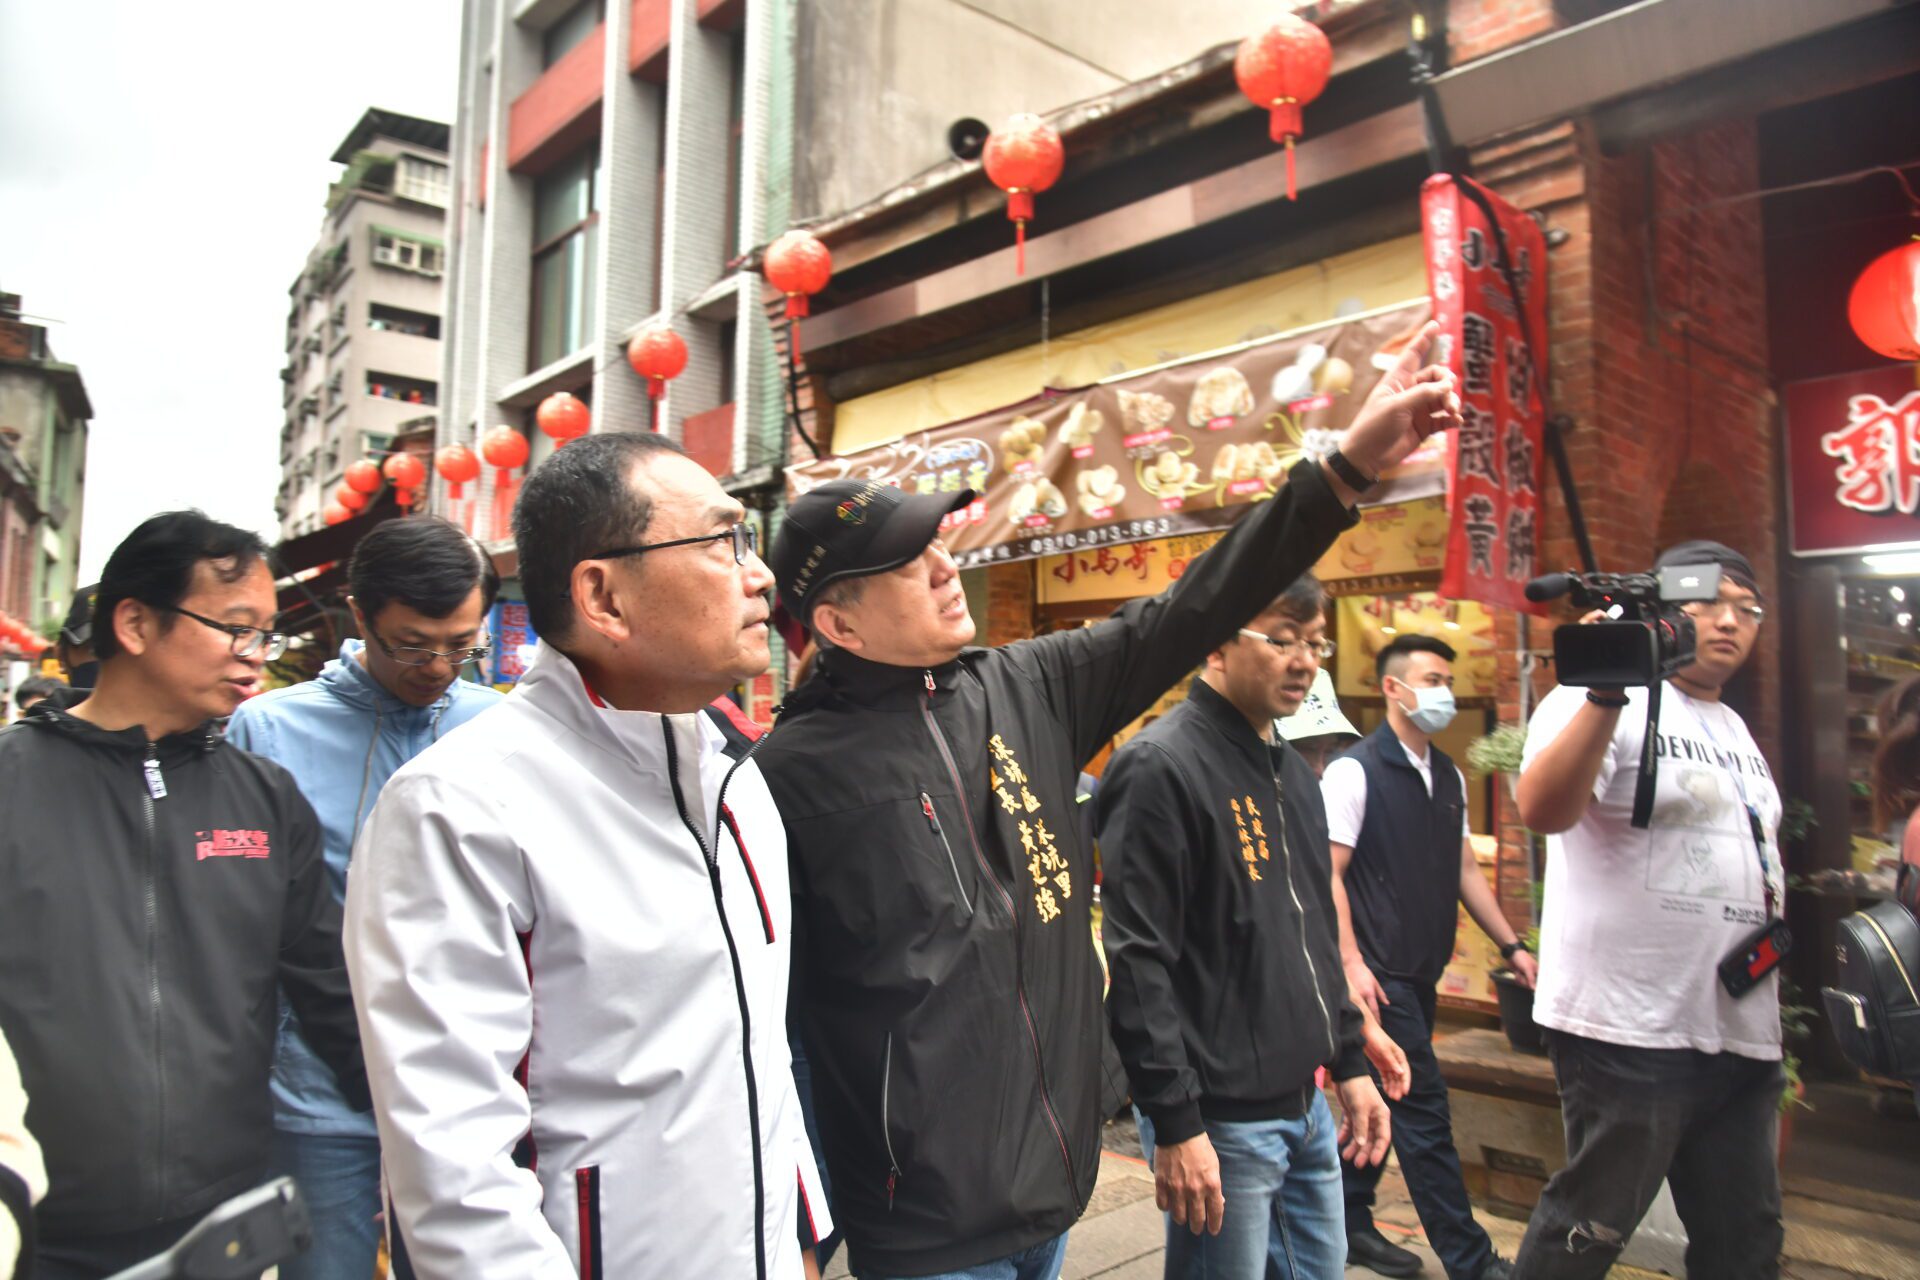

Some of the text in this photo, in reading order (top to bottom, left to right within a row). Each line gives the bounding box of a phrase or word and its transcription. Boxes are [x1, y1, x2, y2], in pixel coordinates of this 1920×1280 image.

[1052, 541, 1157, 585] 小馬哥
[1656, 732, 1713, 765] DEVIL
